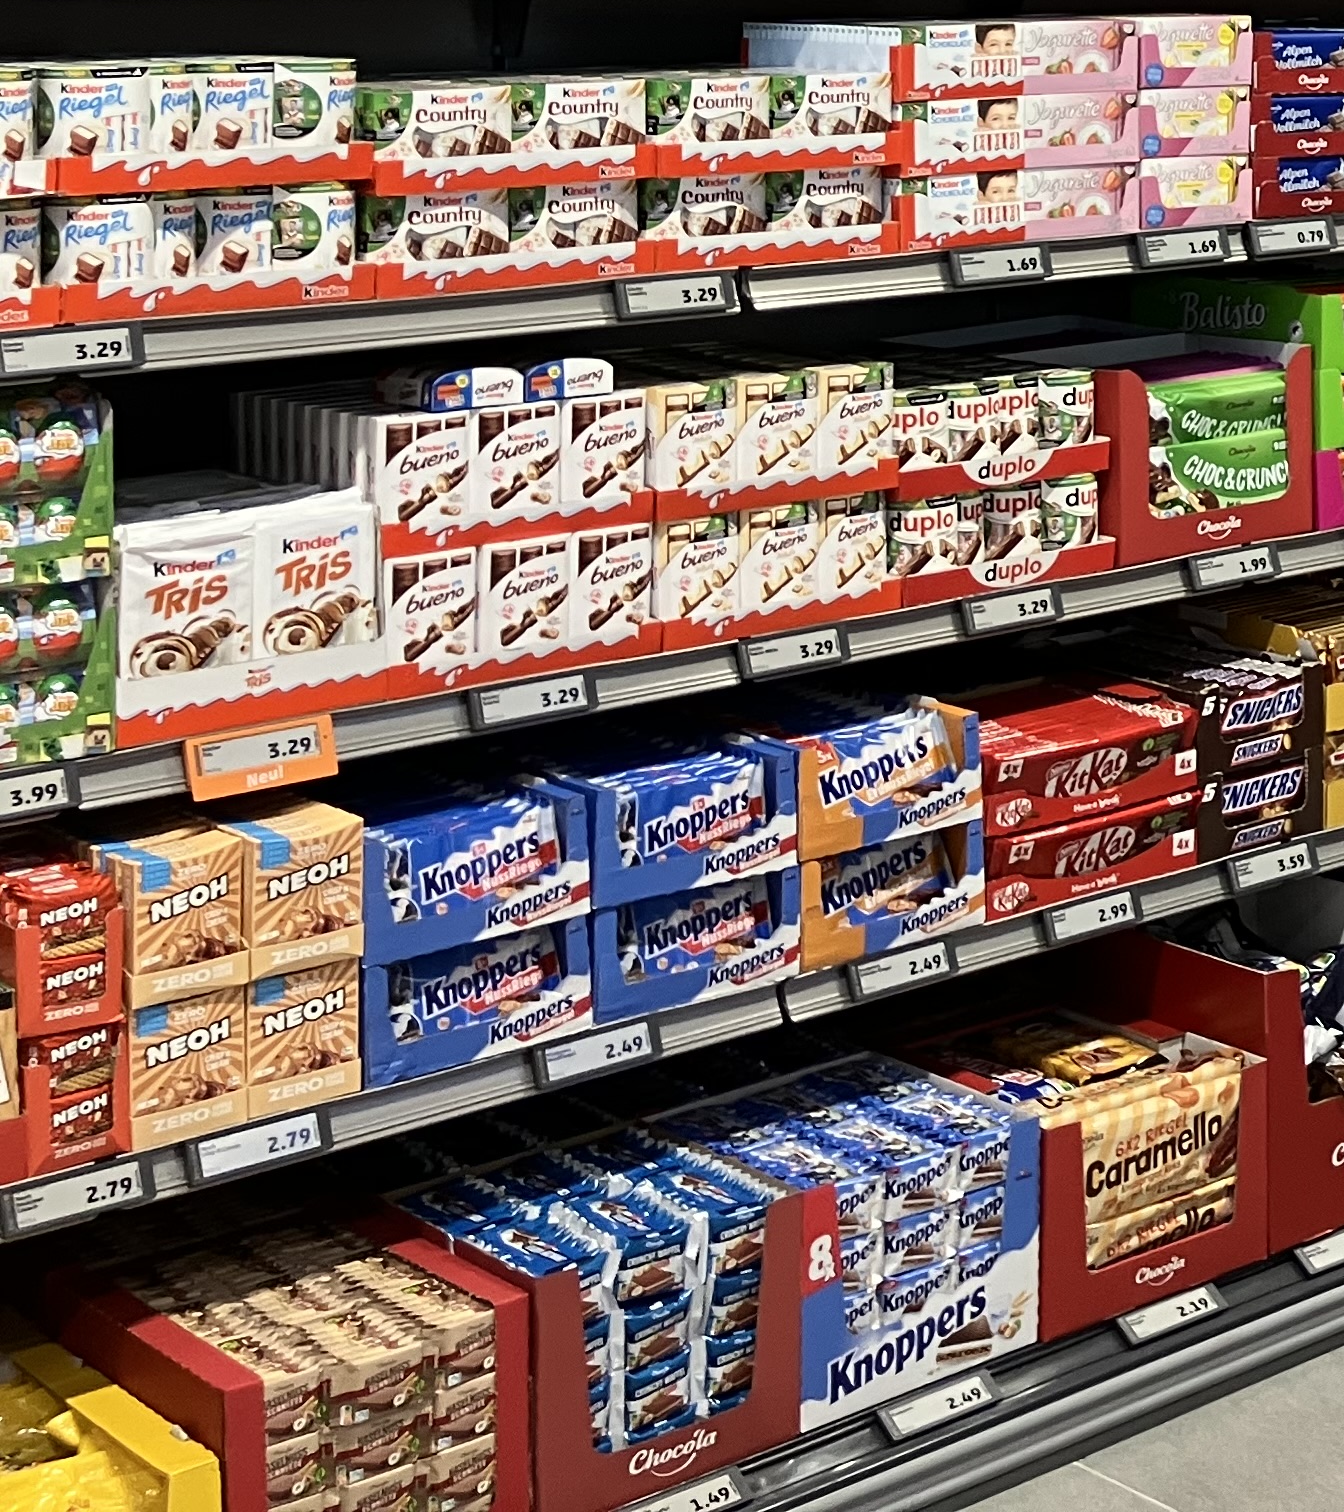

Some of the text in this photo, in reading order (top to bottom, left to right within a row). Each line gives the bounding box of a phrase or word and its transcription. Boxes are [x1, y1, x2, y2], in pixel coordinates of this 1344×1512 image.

[59, 84, 128, 119] Riegel
[548, 100, 619, 118] Country
[415, 106, 487, 125] Country
[548, 197, 615, 215] Country
[1189, 240, 1216, 254] 1.69
[1297, 230, 1324, 244] 0.79
[1008, 258, 1037, 272] 1.69
[682, 287, 718, 304] 3.29
[75, 341, 122, 360] 3.29
[758, 407, 806, 429] bueno
[400, 449, 460, 474] bueno
[978, 455, 1036, 480] duplo
[591, 559, 644, 585] bueno
[984, 558, 1042, 583] duplo
[1239, 557, 1267, 573] 1.99
[800, 639, 834, 659] 3.29
[541, 687, 580, 707] 3.29
[1227, 685, 1302, 730] SNICKERS
[268, 737, 312, 758] 3.29
[1234, 736, 1282, 761] SNICKERS
[819, 734, 928, 807] Knoppers
[10, 783, 57, 807] 3.99
[645, 790, 750, 856] Knoppers
[420, 829, 540, 904] Knoppers
[1278, 853, 1305, 872] 3.59
[268, 854, 350, 900] NEOH
[150, 875, 228, 924] NEOH
[487, 880, 571, 928] Knoppers
[40, 898, 97, 927] NEOH
[1098, 903, 1128, 922] 2.99
[270, 940, 327, 966] ZERO
[909, 955, 942, 975] 2.49
[151, 965, 210, 992] ZERO
[146, 1018, 230, 1067] NEOH
[605, 1036, 643, 1059] 2.49
[268, 1129, 311, 1153] 2.79
[1144, 1113, 1188, 1148] RIEGEL
[1085, 1110, 1223, 1198] Caramello
[86, 1178, 133, 1204] 2.79
[1176, 1296, 1209, 1319] 2.19
[828, 1286, 986, 1404] Knoppers
[945, 1387, 981, 1409] 2.49
